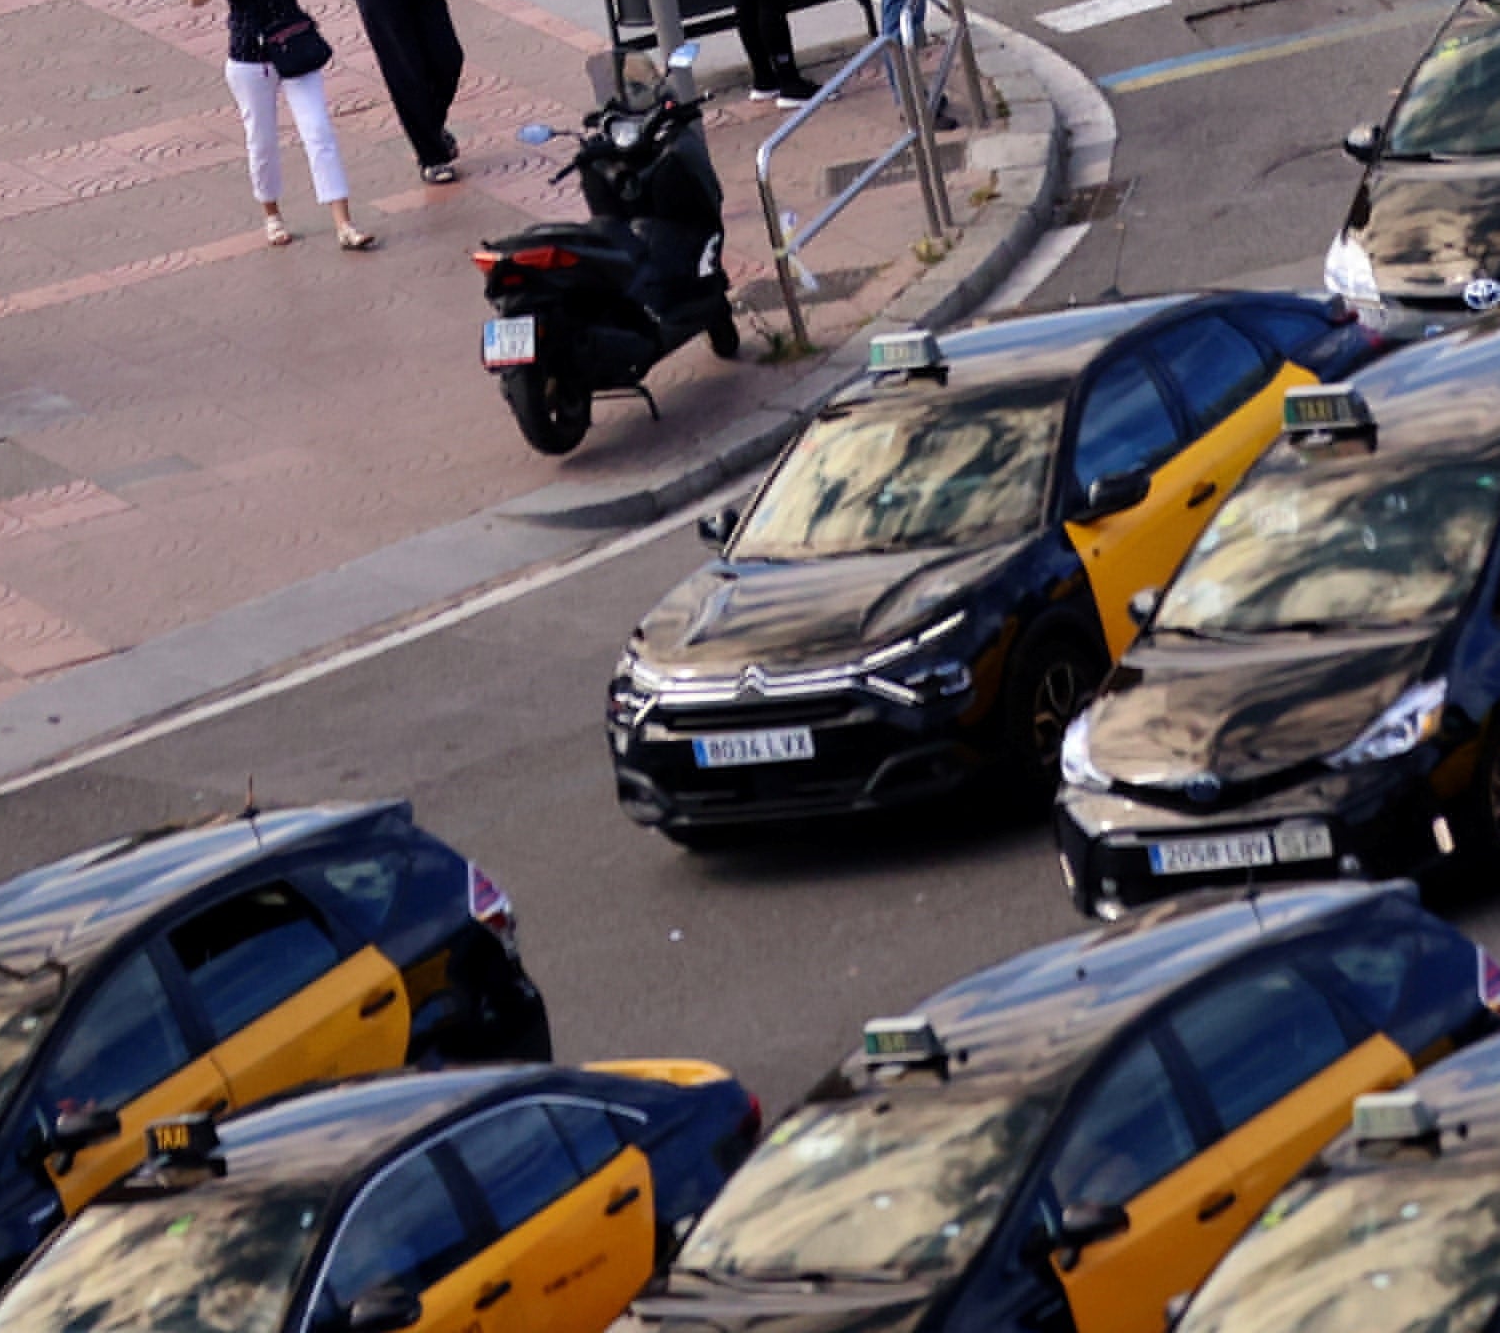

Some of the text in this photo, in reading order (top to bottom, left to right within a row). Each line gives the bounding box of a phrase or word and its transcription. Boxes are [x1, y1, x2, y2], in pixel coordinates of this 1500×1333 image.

[1297, 401, 1330, 421] TAXI
[763, 732, 806, 758] LVX
[1278, 829, 1327, 855] SP
[154, 1125, 189, 1150] TAXI
